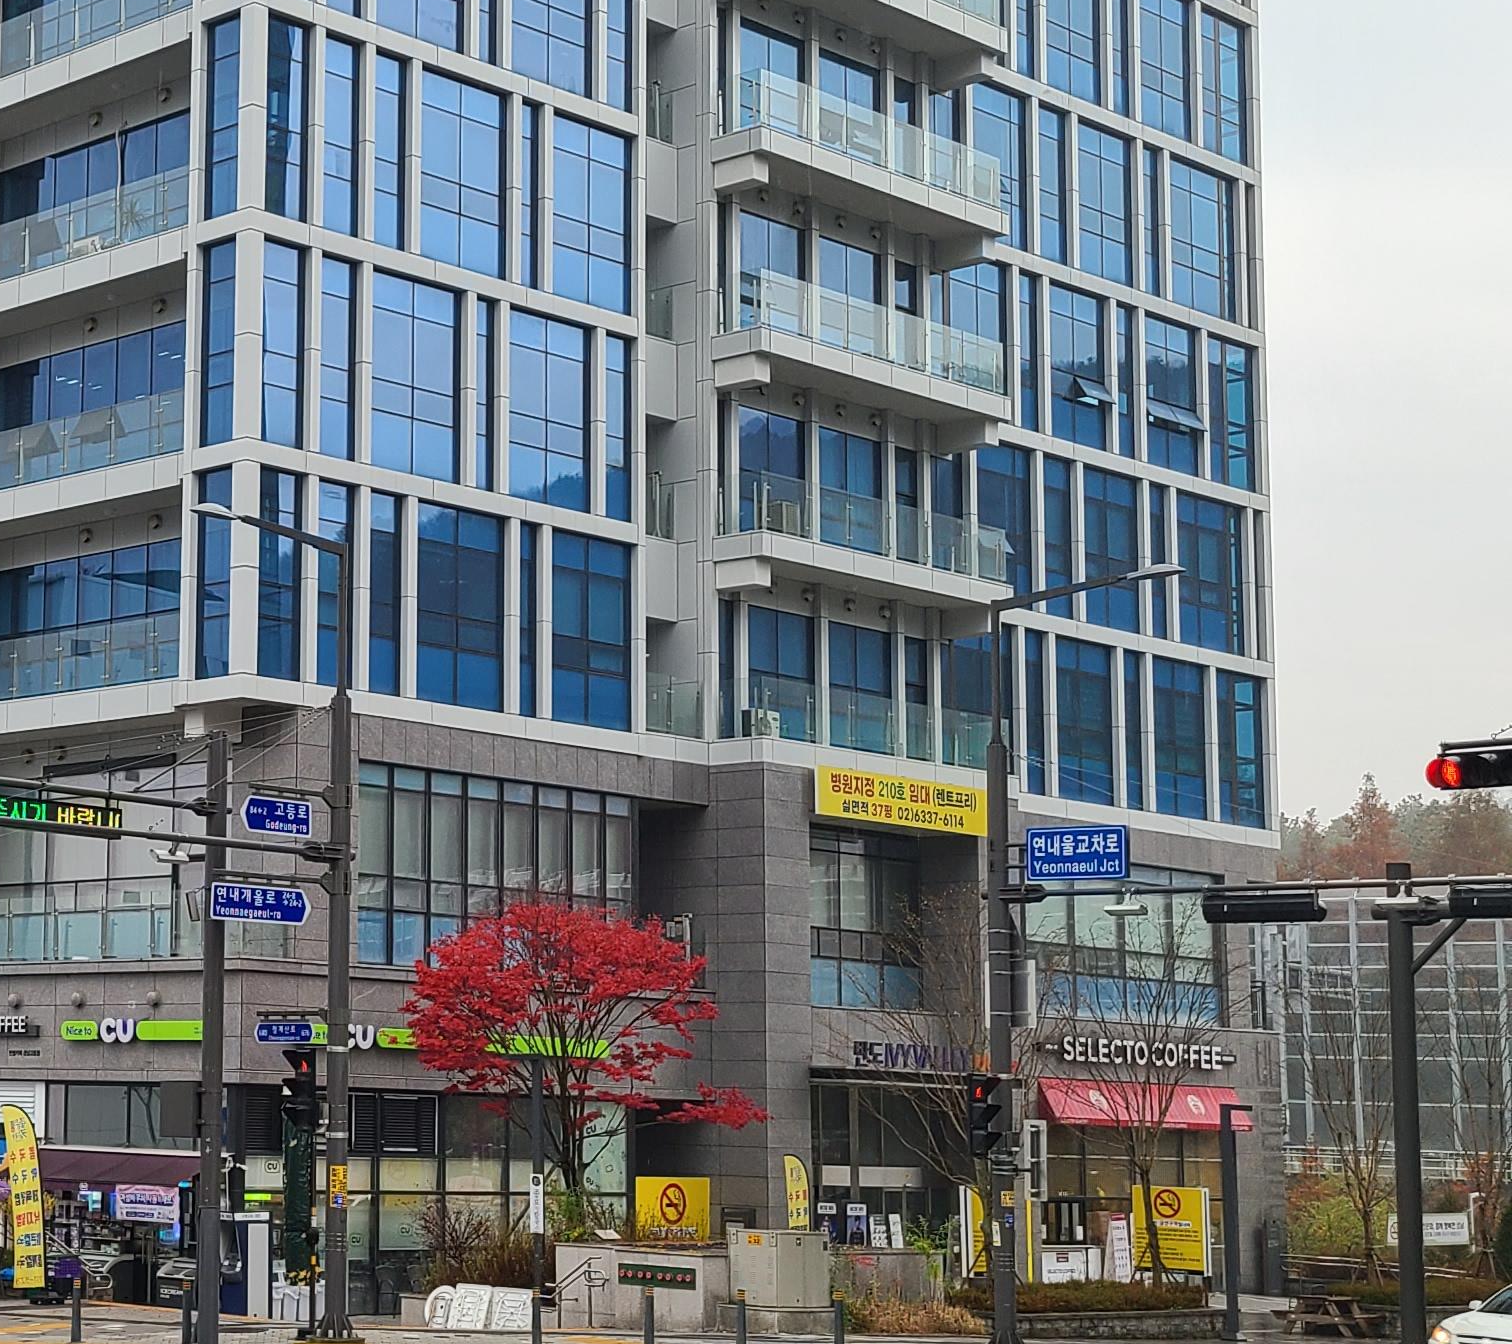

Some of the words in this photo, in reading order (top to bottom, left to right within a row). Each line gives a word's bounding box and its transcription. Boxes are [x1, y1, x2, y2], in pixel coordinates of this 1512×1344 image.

[830, 772, 875, 798] 병원지정
[878, 780, 906, 801] 210호
[909, 783, 931, 805] 임대
[932, 786, 977, 813] (렌트프리)
[274, 803, 308, 820] 고등로
[842, 799, 869, 816] 실면적
[871, 803, 893, 819] 37평
[897, 806, 965, 828] 02)6337-6114
[265, 819, 308, 834] Godeung-ro
[1032, 833, 1120, 857] 연내울교차로
[1033, 858, 1097, 874] Yeonnaeul
[1100, 858, 1120, 872] Jct
[216, 887, 276, 906] 연내개울로
[215, 905, 282, 920] Yeonnaegaeul-ro
[99, 1017, 135, 1044] CU
[1063, 1036, 1149, 1066] SELECTO
[1152, 1041, 1223, 1070] COFFEE
